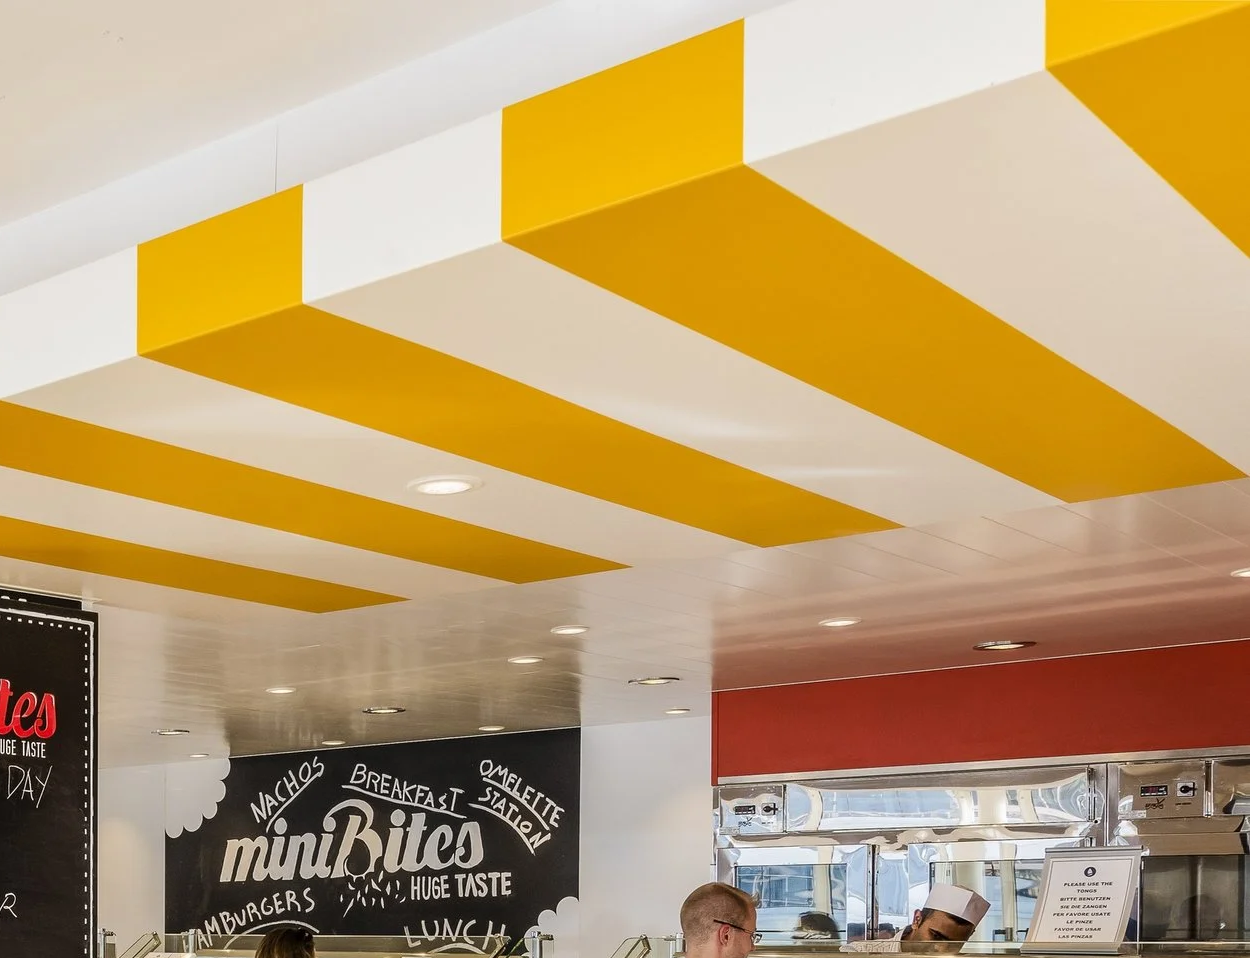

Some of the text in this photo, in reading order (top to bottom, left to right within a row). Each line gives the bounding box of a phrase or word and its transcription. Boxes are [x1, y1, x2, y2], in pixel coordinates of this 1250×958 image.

[21, 740, 47, 759] TASTE
[6, 765, 52, 808] DAY
[251, 756, 325, 824] NACHOS
[350, 763, 466, 812] BREAKFAST
[479, 759, 565, 828] OMELETTE
[219, 799, 484, 883] miniBites
[478, 786, 551, 850] STATION
[410, 871, 512, 900] HUGE TASTE
[403, 917, 507, 951] LUNCH
